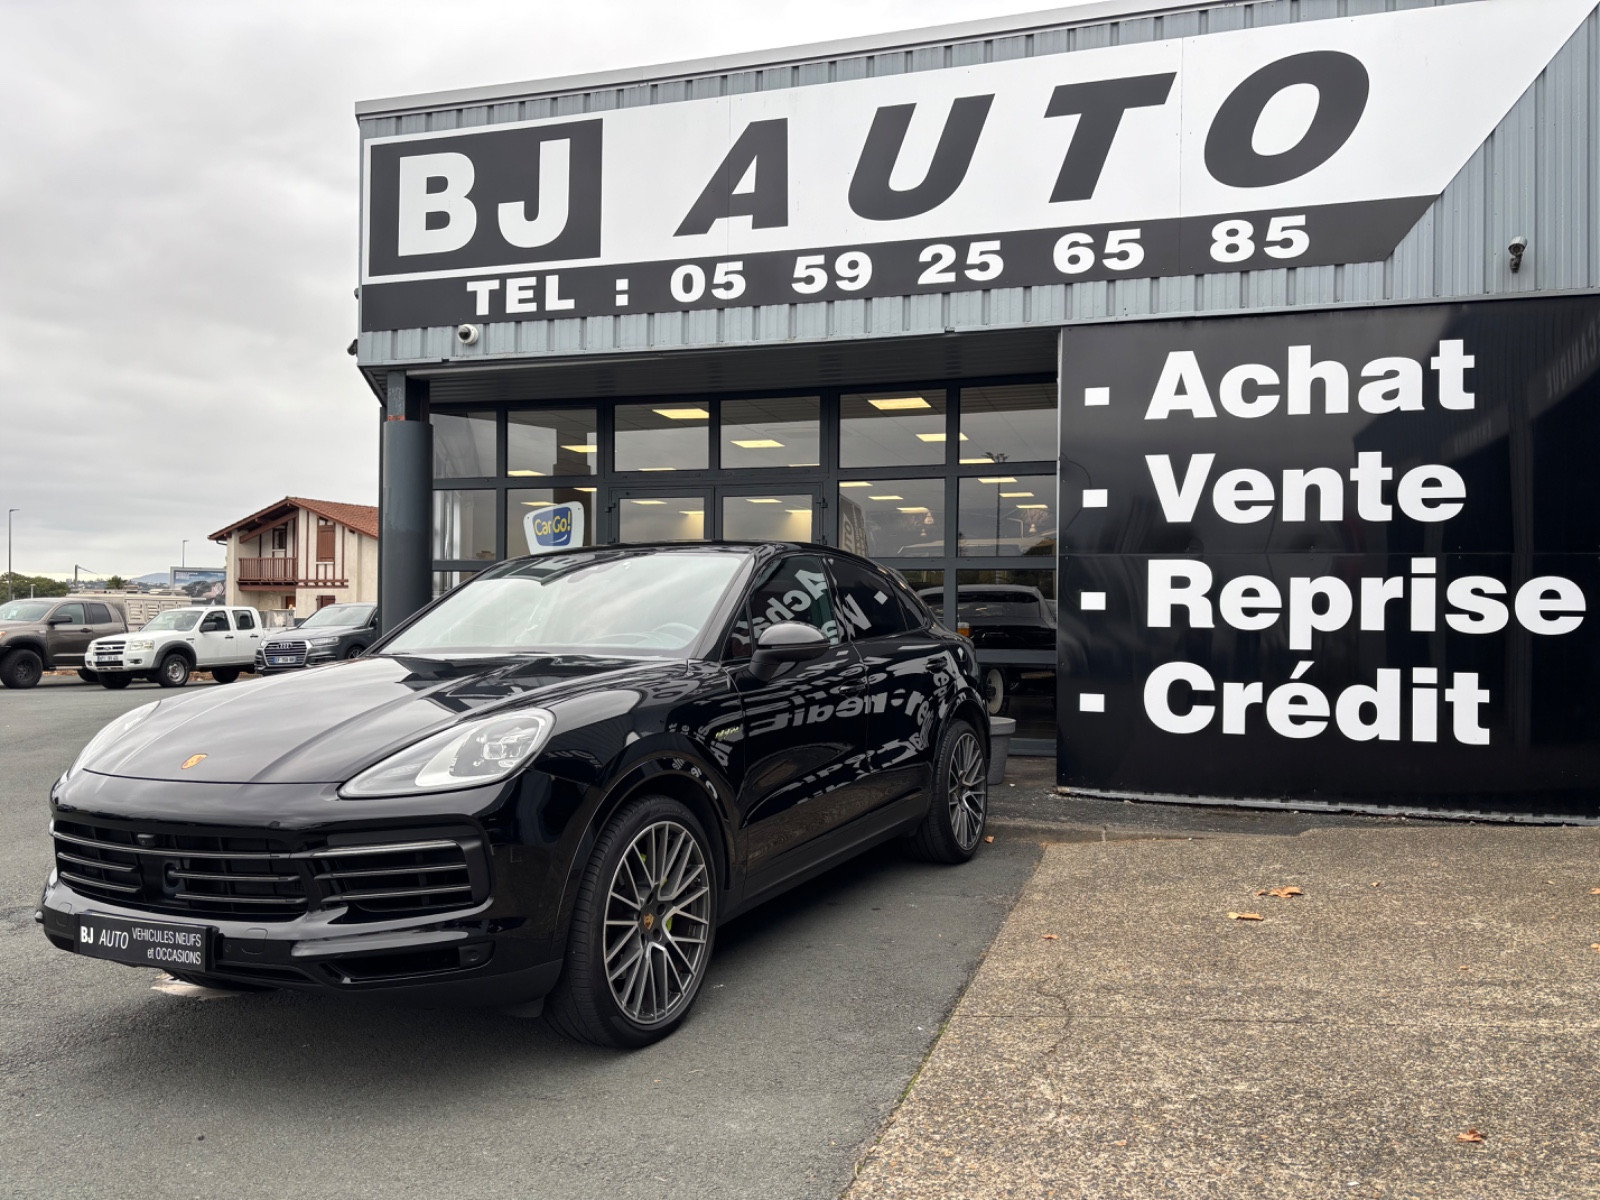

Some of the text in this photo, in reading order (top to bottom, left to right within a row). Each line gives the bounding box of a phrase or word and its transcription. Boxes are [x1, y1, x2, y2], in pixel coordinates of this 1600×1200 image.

[398, 51, 1369, 256] BJ AUTO
[467, 275, 575, 315] TEL
[671, 261, 746, 302] 05
[792, 251, 872, 294] 59
[918, 240, 1004, 284] 25
[1053, 229, 1144, 274] 65
[1210, 215, 1309, 262] 85
[1144, 340, 1474, 420] Achat
[1145, 452, 1466, 523] Vente
[1148, 558, 1585, 650] Reprise
[1144, 661, 1489, 744] Crédit
[80, 926, 129, 949] BJ AUTO
[131, 927, 201, 947] VEHICULES NEUFS
[147, 947, 201, 965] et OCCASIONS
